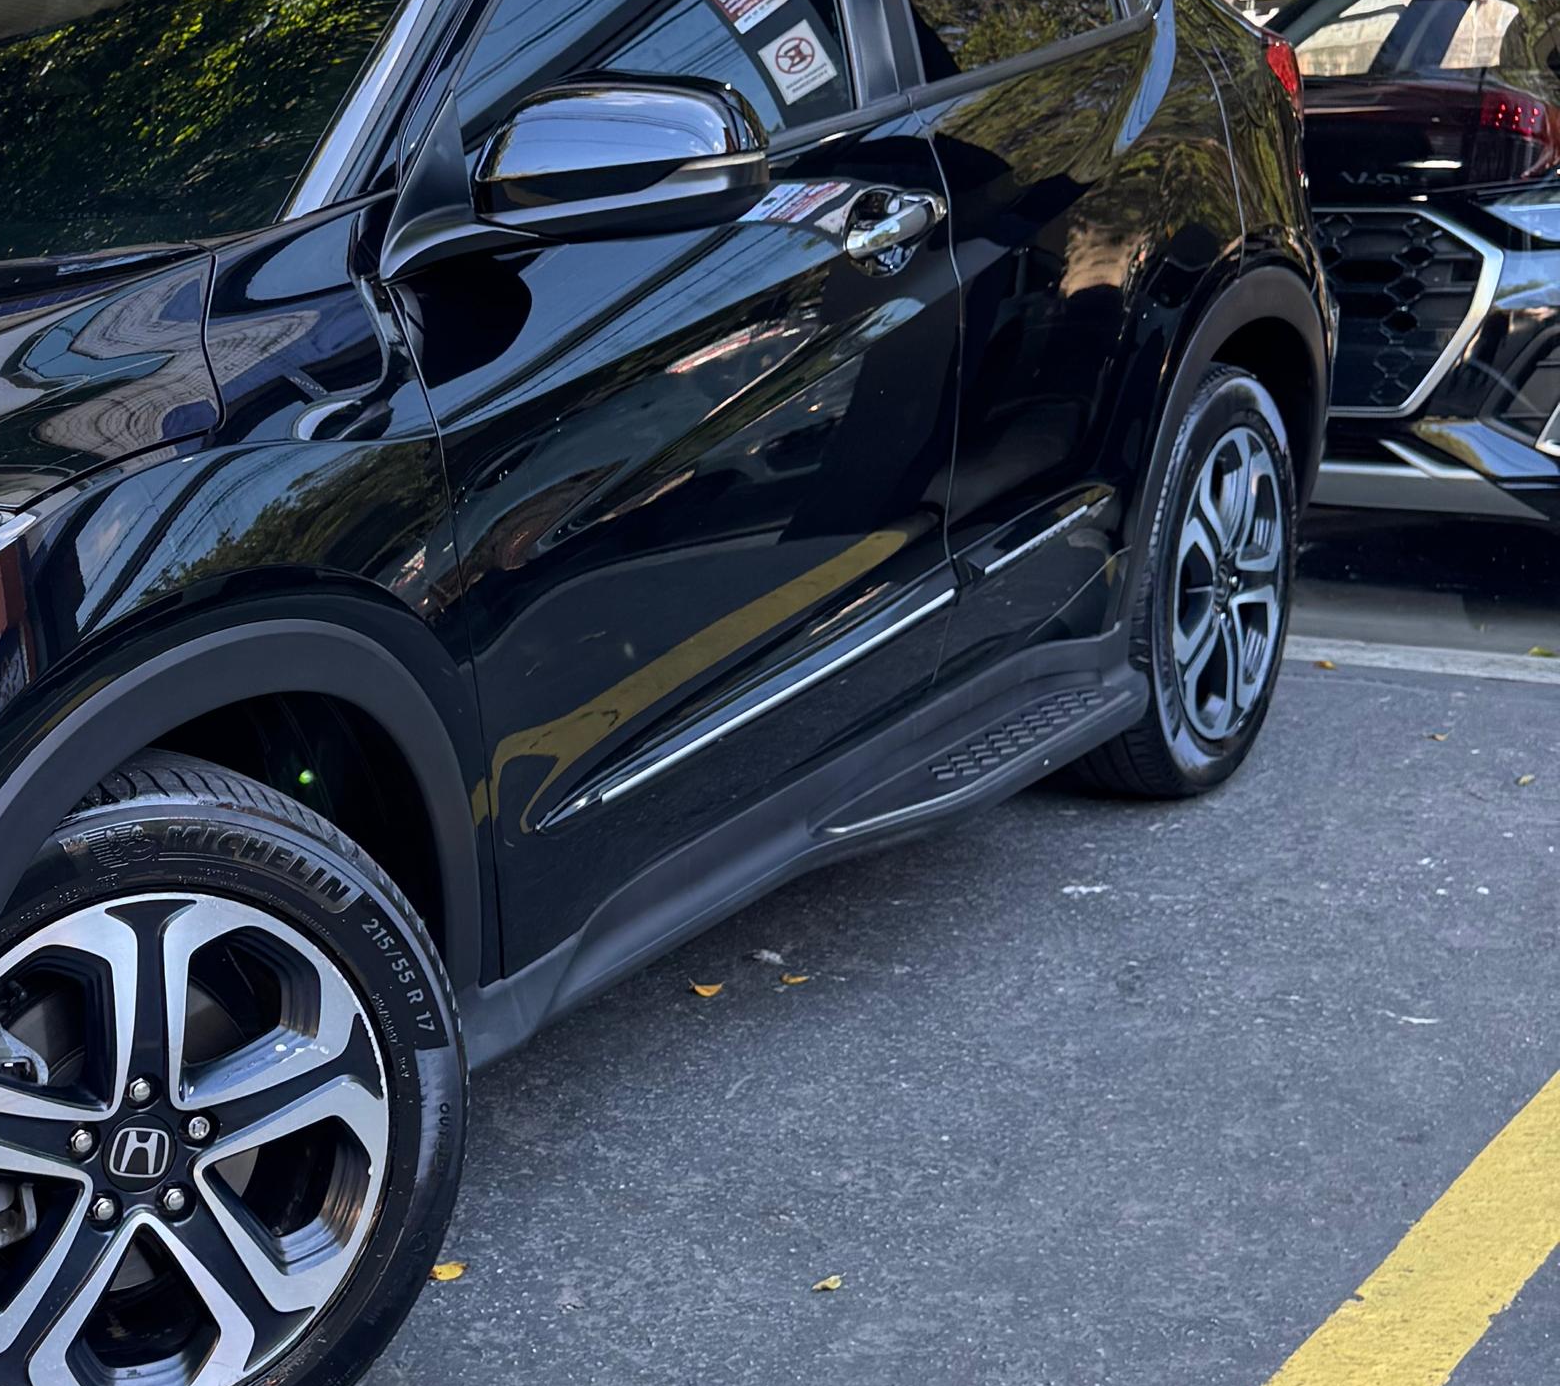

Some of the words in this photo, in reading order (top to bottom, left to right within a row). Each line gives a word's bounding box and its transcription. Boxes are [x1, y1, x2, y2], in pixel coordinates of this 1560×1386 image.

[165, 824, 351, 905] MICHELIN
[362, 918, 416, 984] 215/55
[406, 988, 424, 1005] R
[415, 1011, 436, 1032] 17
